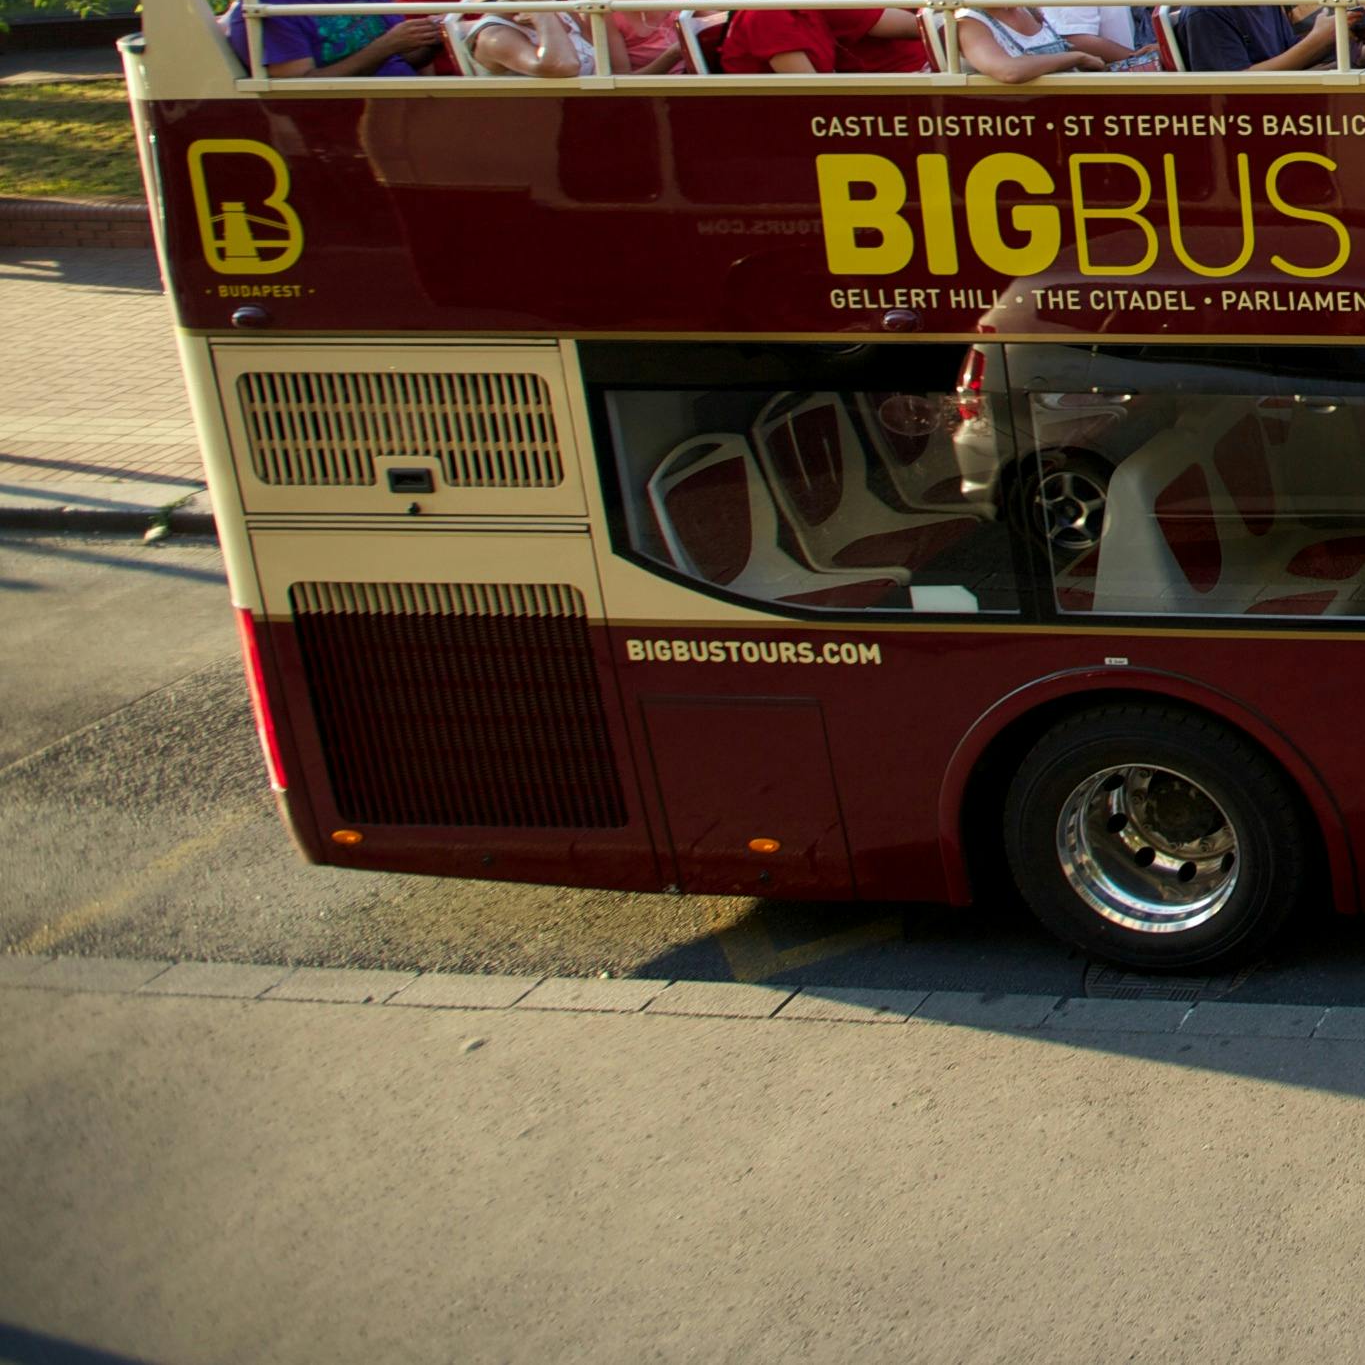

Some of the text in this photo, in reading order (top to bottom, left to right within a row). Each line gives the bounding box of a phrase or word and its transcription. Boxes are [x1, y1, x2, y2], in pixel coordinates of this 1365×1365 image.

[812, 115, 909, 137] CASTLE
[918, 115, 1036, 137] DISTRICT
[1063, 115, 1094, 137] ST
[1104, 114, 1253, 137] STEPHEN'S
[218, 285, 301, 298] BUDAPEST
[830, 288, 941, 311] GELLERT
[949, 289, 1008, 311] HILL
[1032, 289, 1082, 311] THE
[1089, 289, 1196, 311] CITADEL
[626, 639, 882, 665] BIGBUSTOURS.COM
